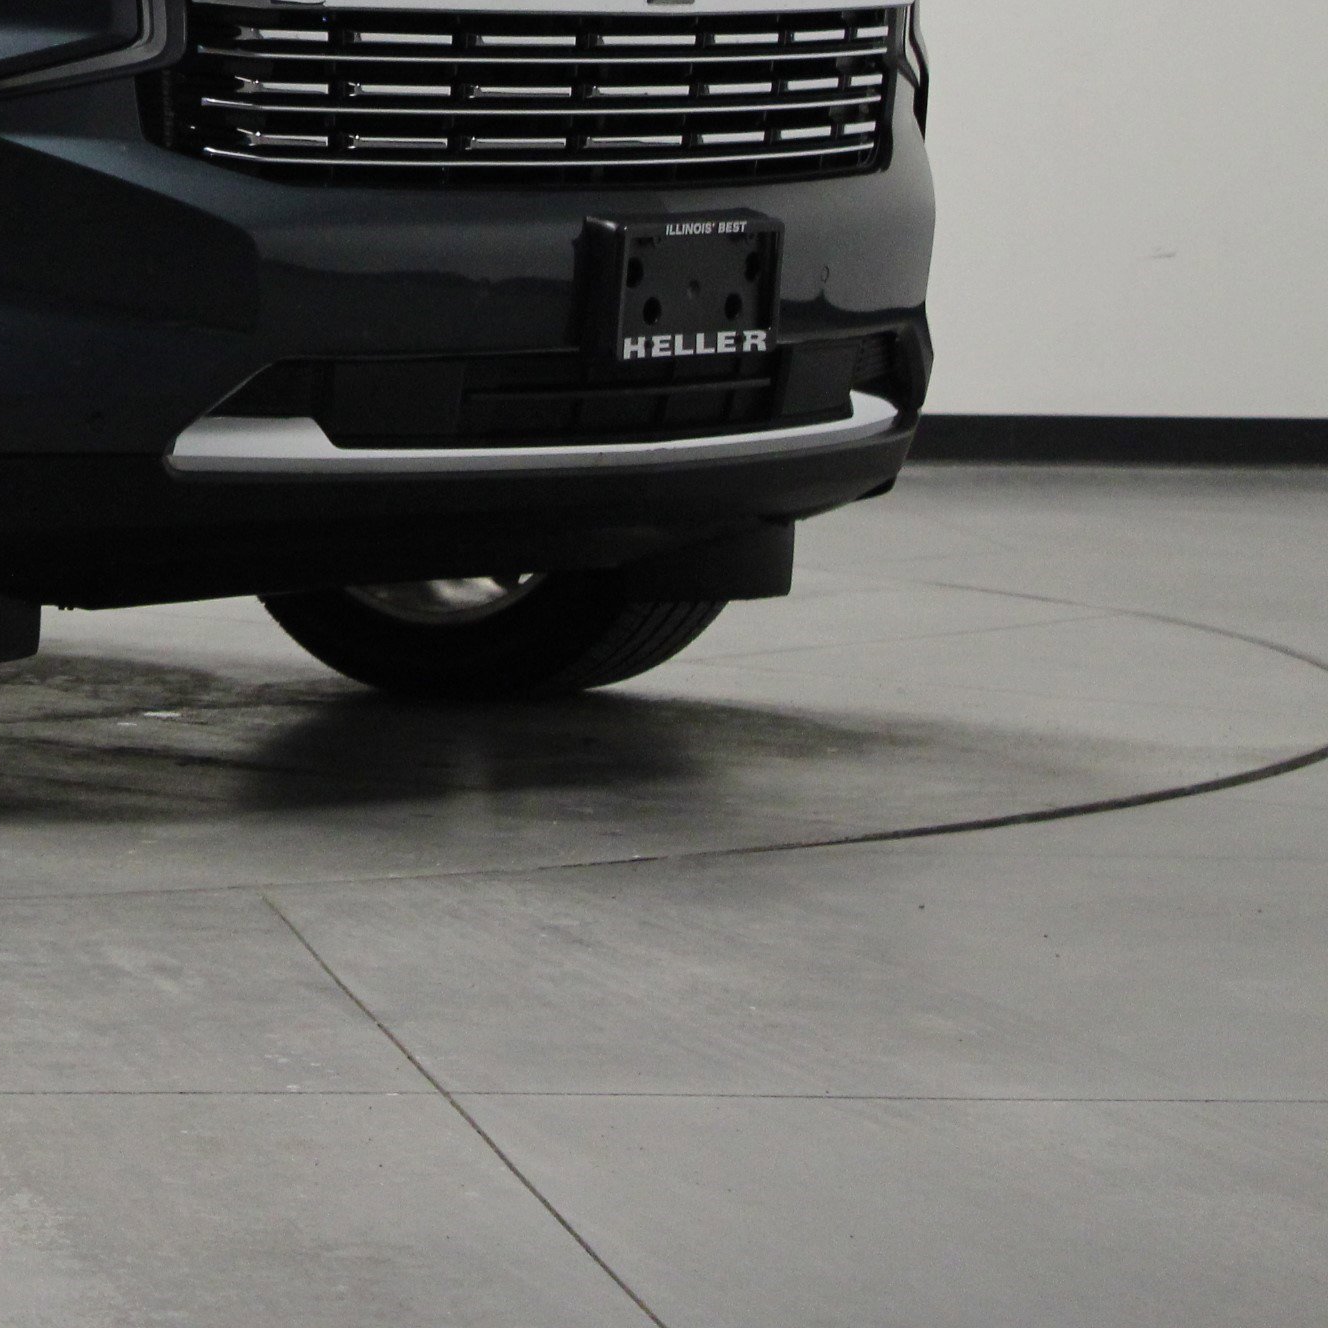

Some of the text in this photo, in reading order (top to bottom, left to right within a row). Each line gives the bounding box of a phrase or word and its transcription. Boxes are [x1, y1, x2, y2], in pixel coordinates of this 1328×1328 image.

[665, 221, 747, 236] ILLINOIS' BEST
[623, 329, 767, 360] HELLER
